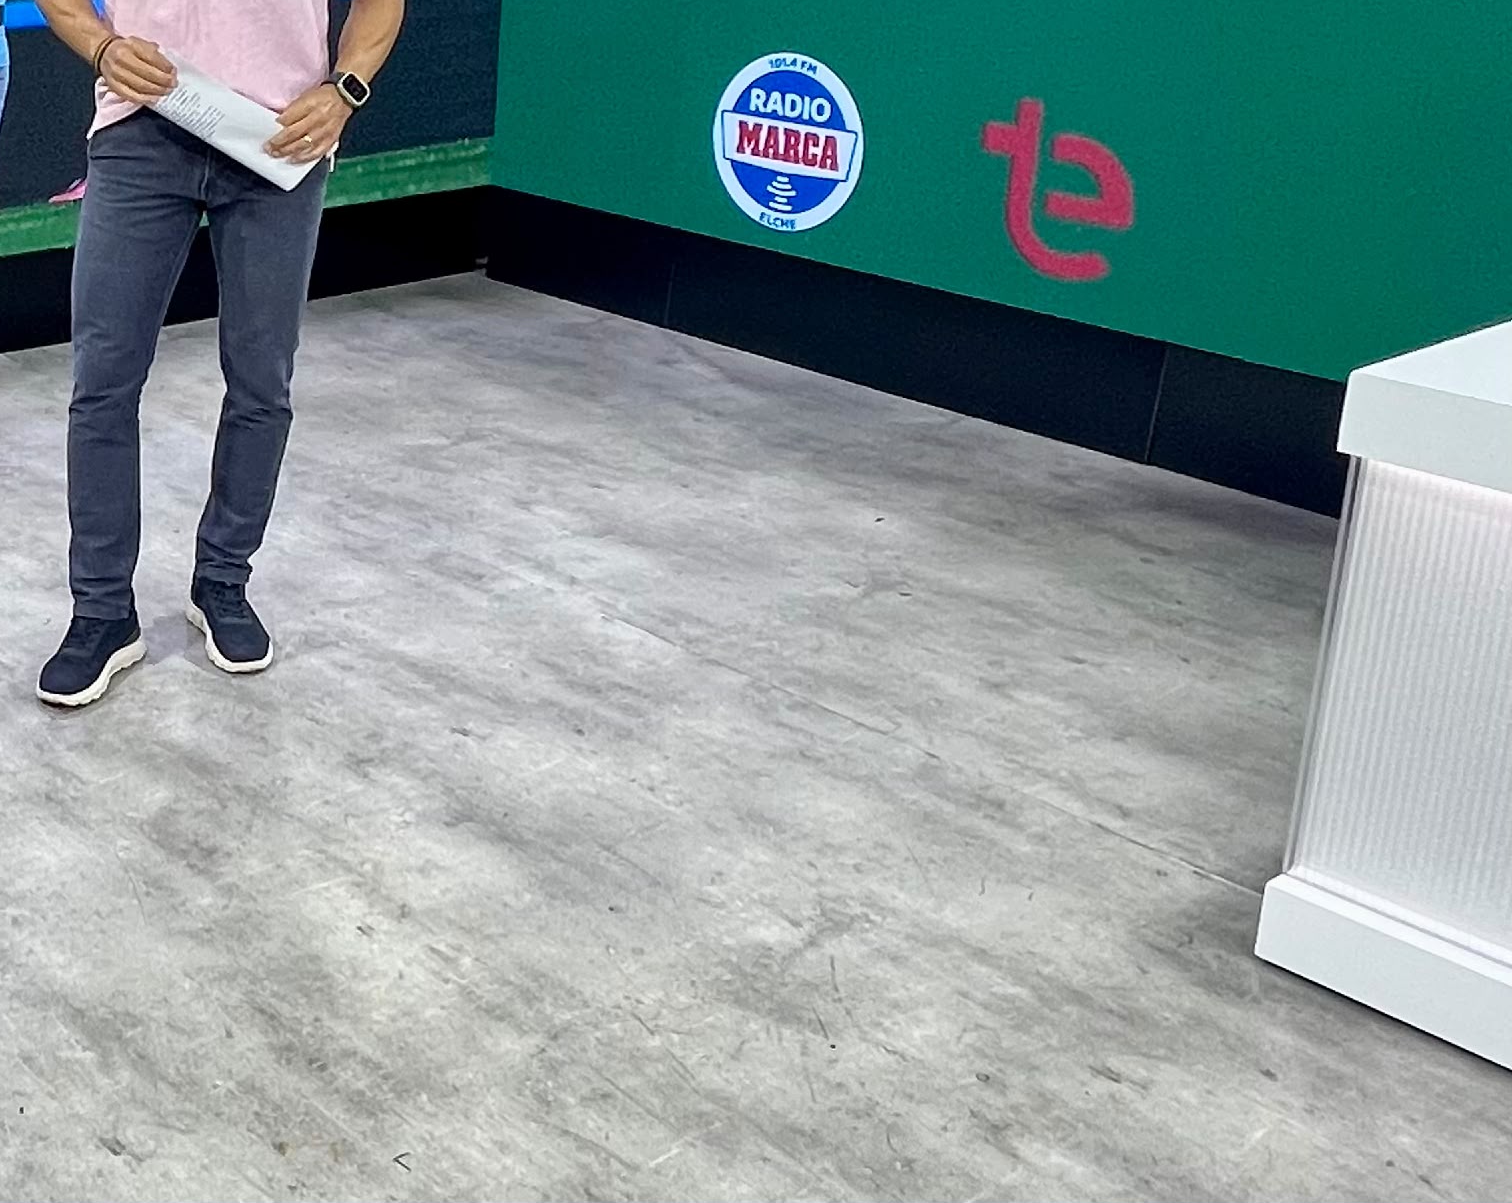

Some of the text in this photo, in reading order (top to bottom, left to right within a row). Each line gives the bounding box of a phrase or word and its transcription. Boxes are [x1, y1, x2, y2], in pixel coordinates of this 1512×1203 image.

[800, 60, 818, 75] FM
[749, 88, 831, 122] RADIO
[736, 121, 839, 171] MARCA
[759, 211, 797, 230] ELCHE
